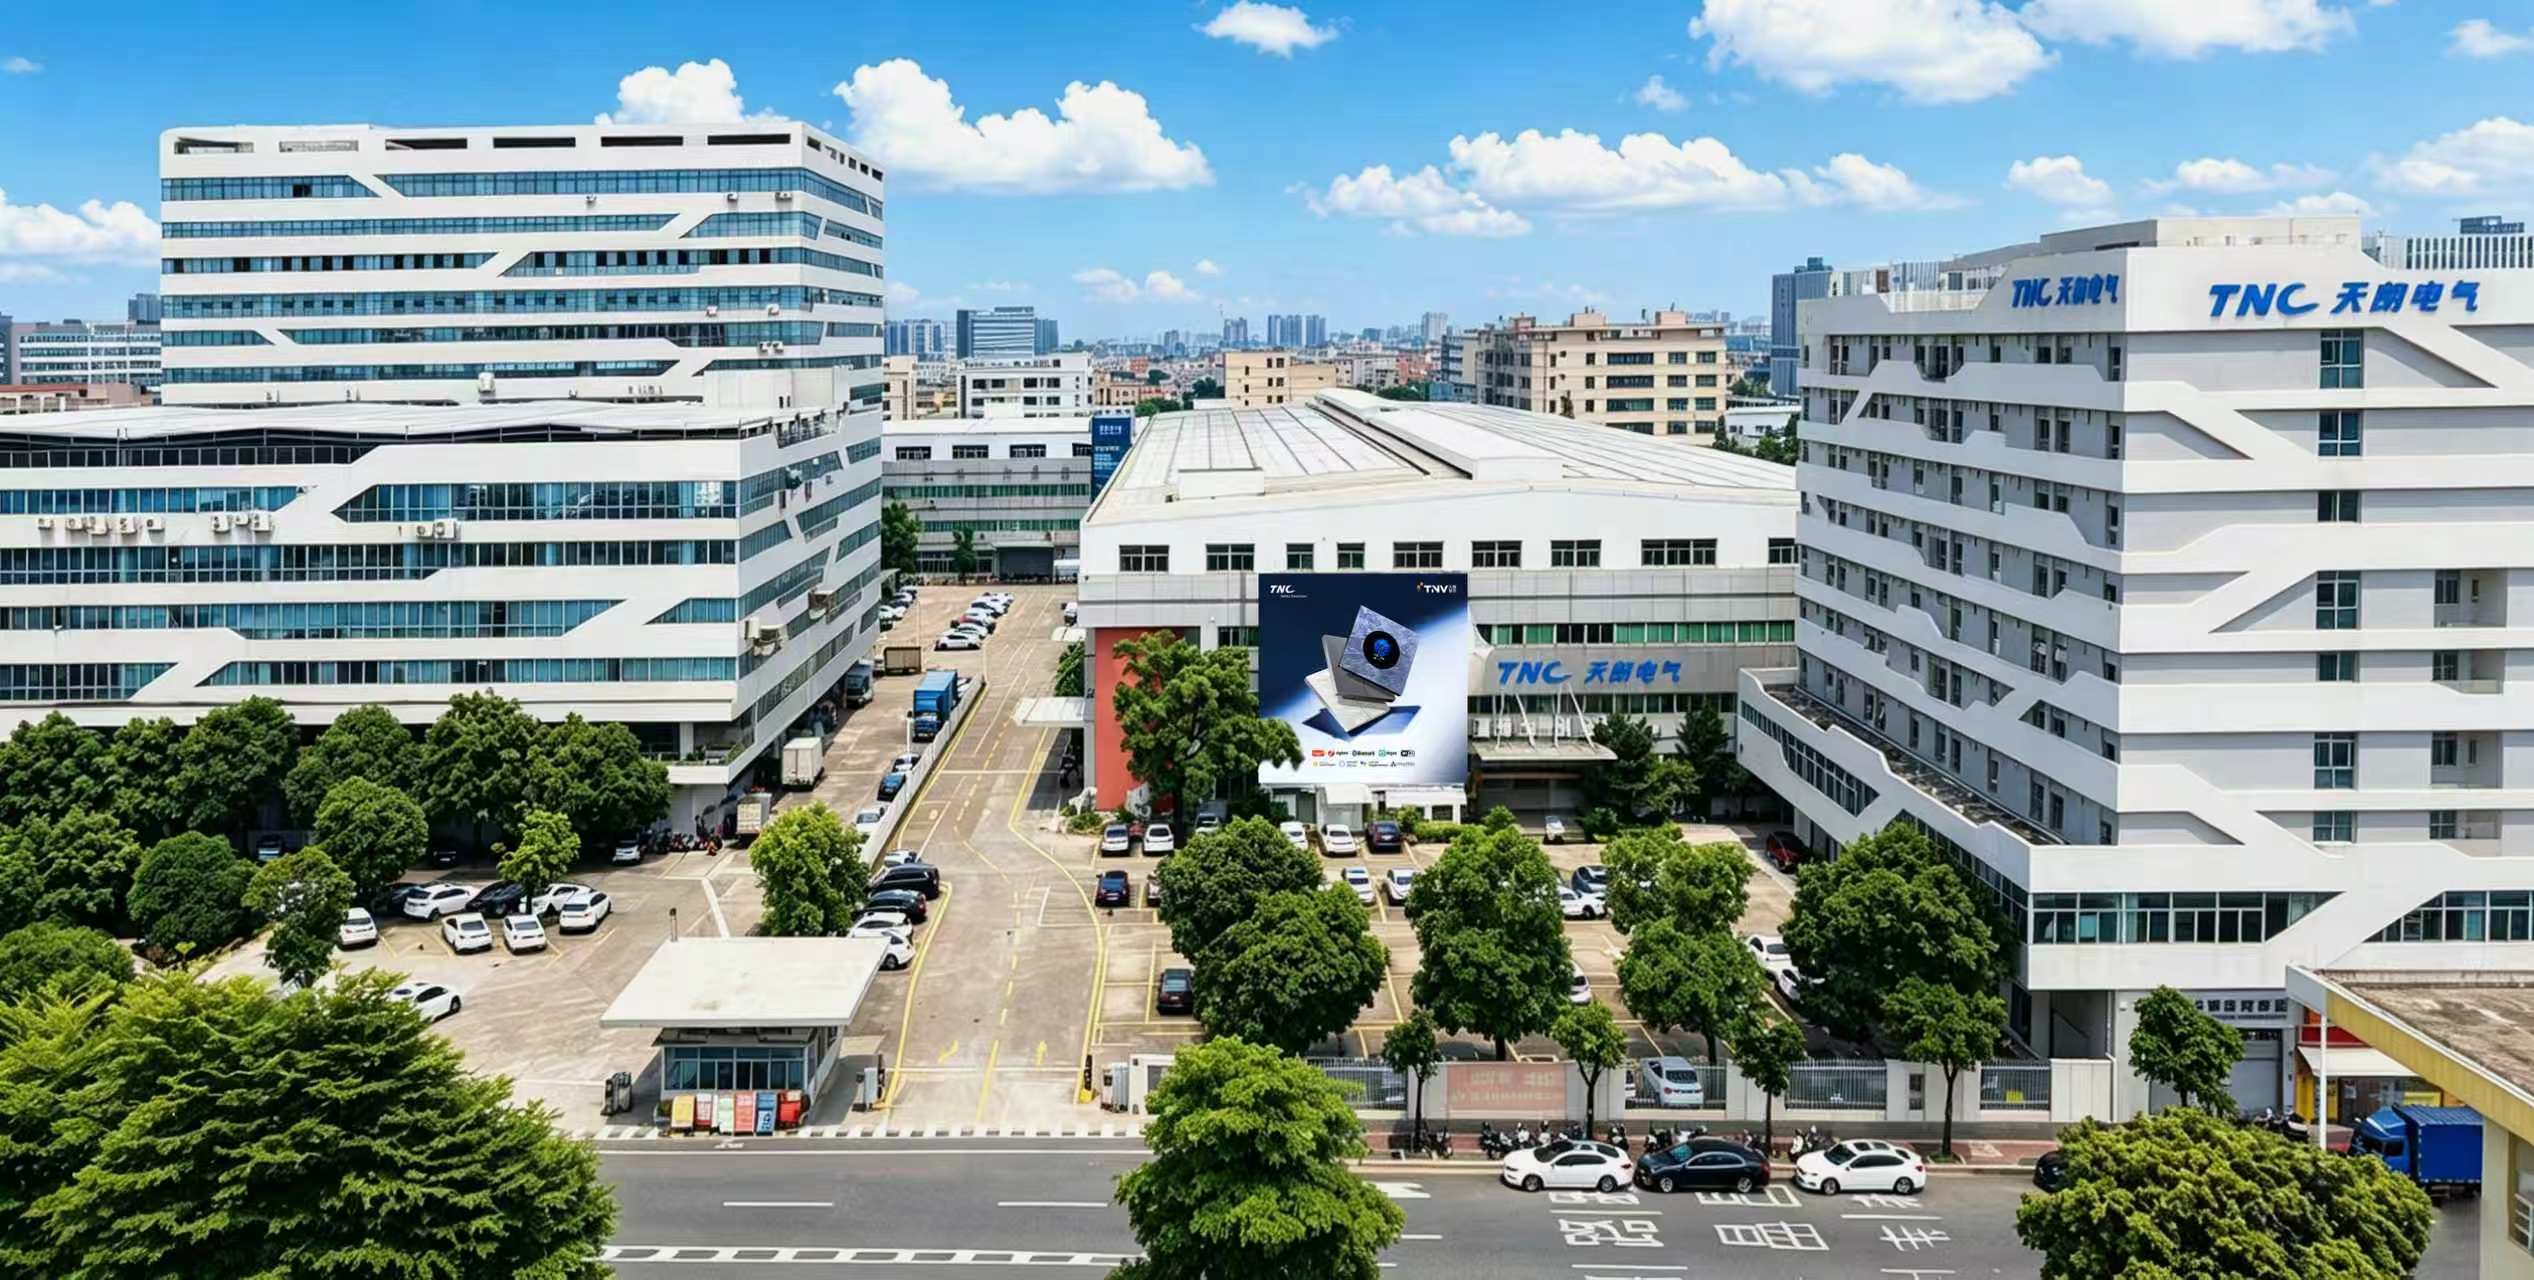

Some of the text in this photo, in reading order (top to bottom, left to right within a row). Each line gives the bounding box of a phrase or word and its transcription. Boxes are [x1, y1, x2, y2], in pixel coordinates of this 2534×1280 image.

[2057, 273, 2120, 305] 天朗电气
[2210, 281, 2479, 317] TNC 天朗电气
[1270, 584, 1295, 594] TNC
[1498, 660, 1681, 685] TNC 天朗电气
